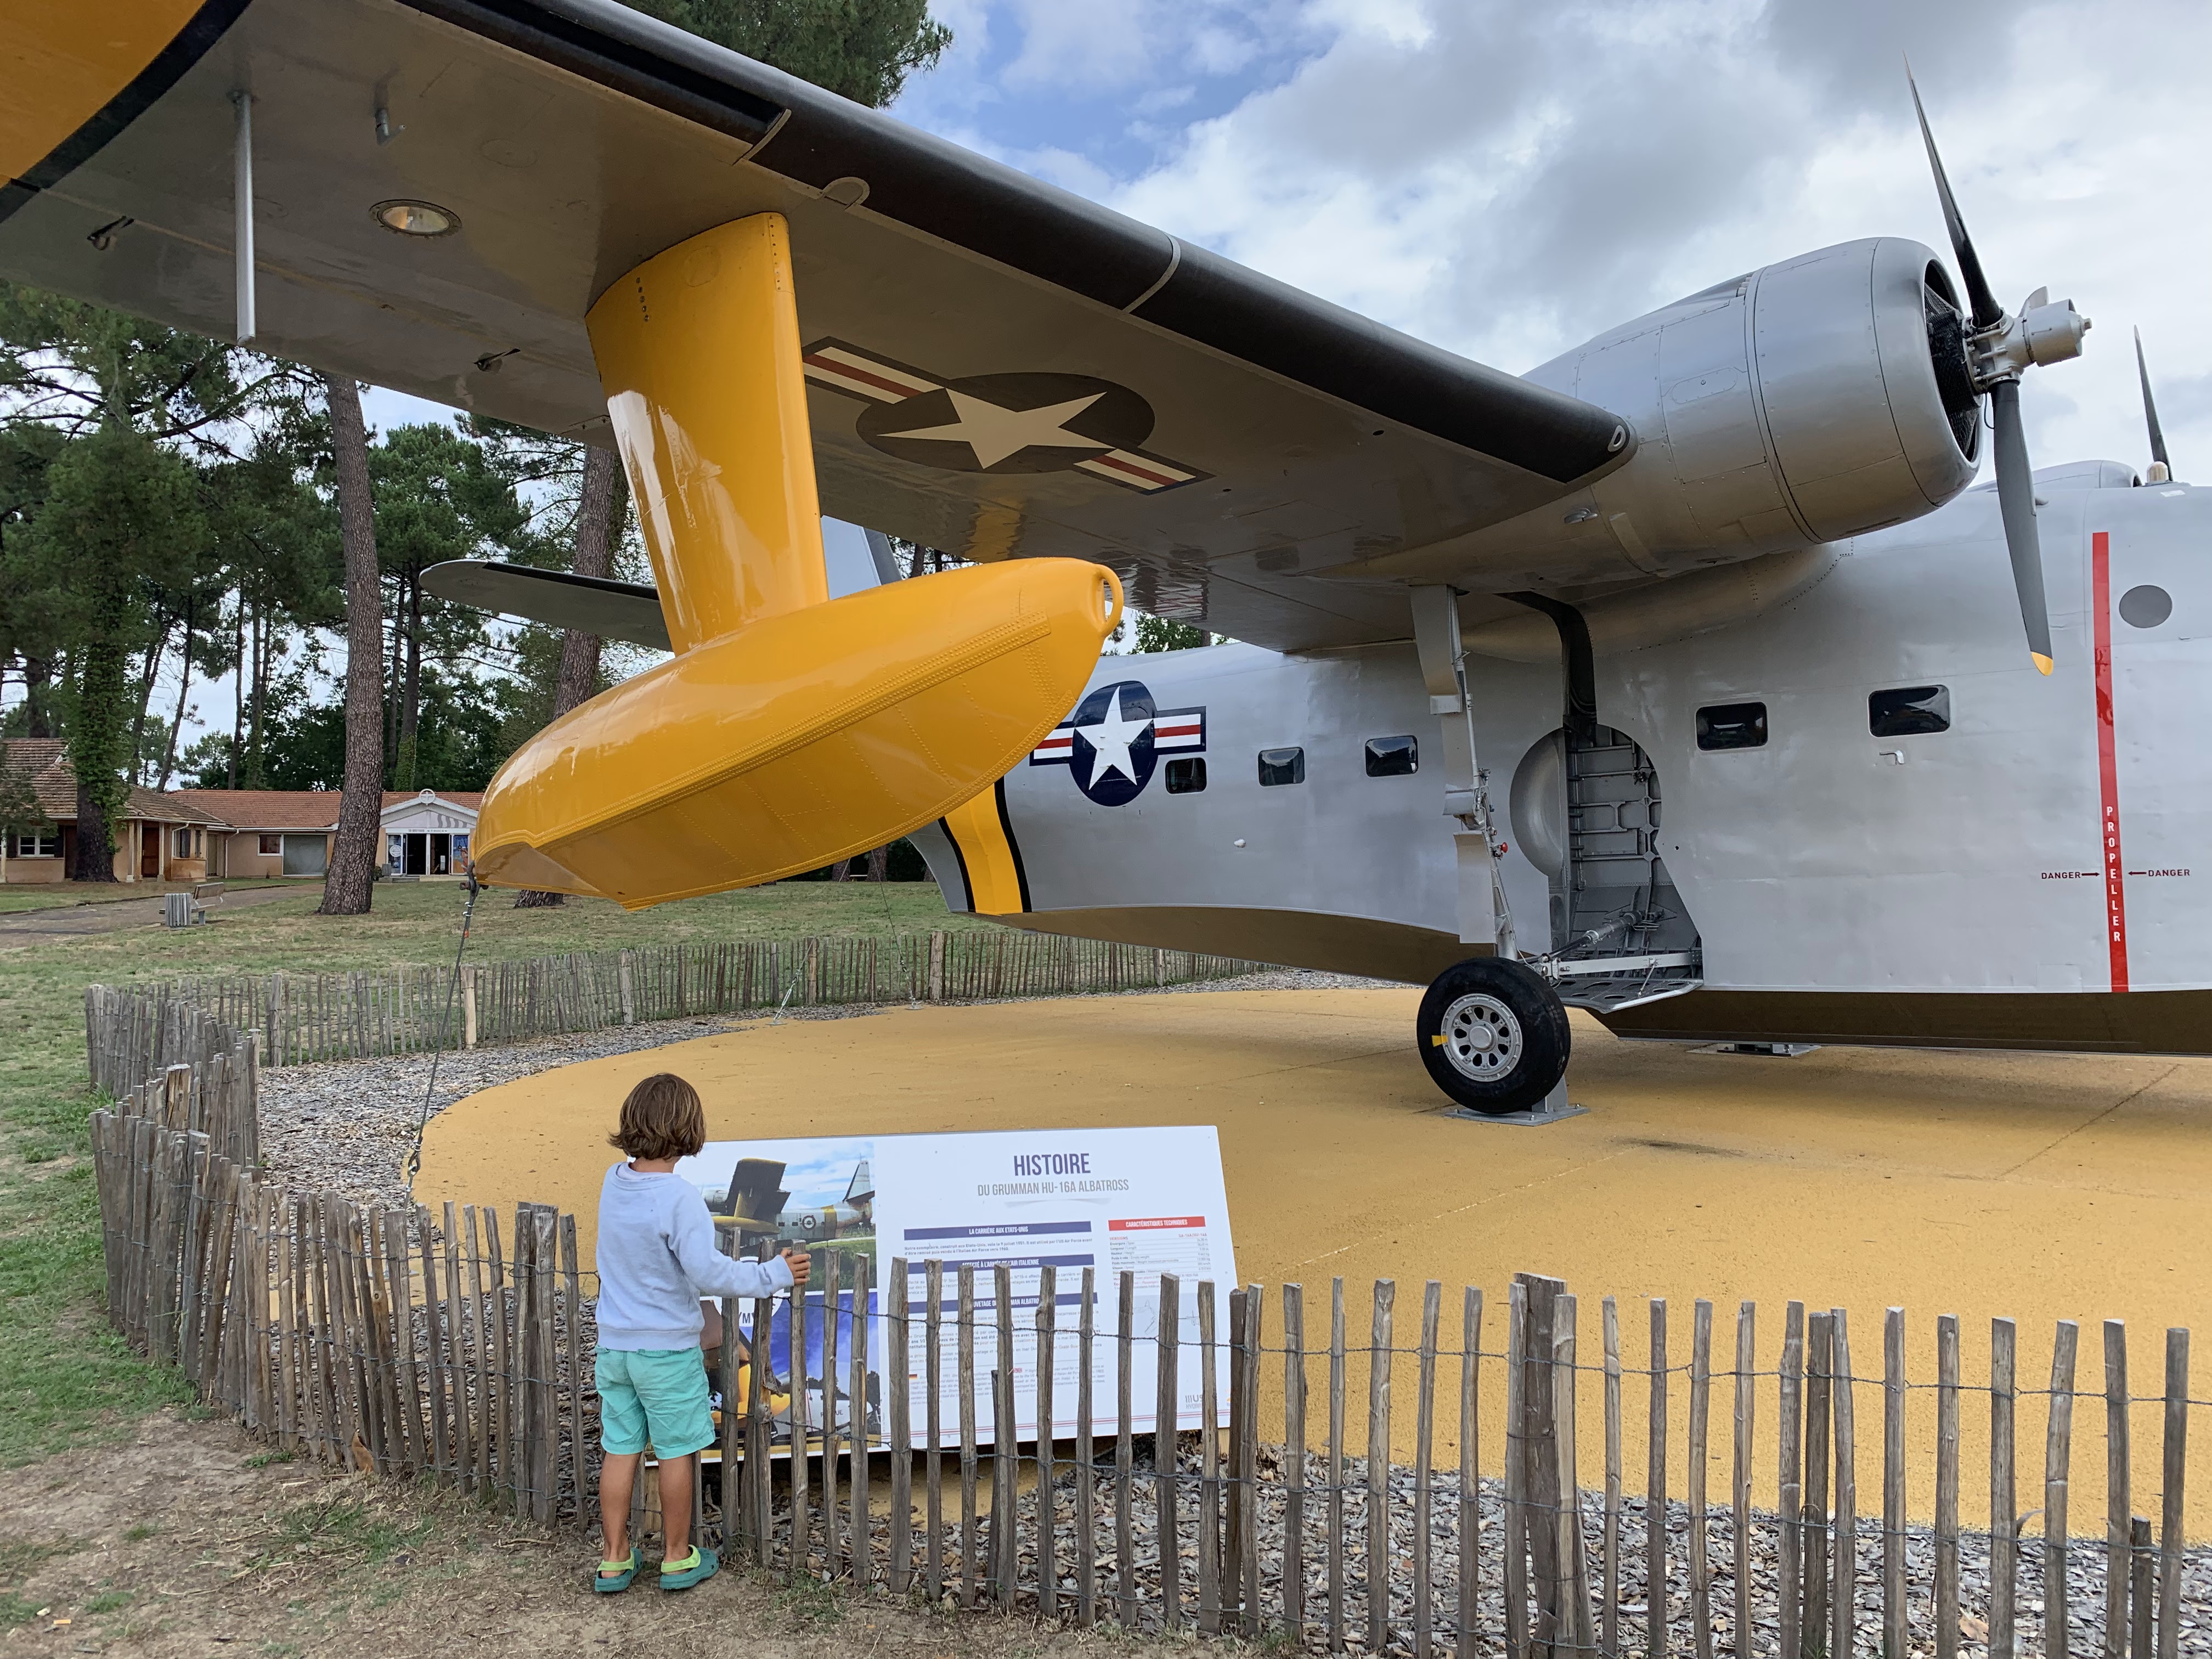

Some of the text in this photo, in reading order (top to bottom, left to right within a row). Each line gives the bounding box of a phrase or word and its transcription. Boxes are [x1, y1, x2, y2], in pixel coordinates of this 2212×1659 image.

[2041, 871, 2081, 879] DANGER
[2107, 806, 2121, 942] PROPELLER
[1013, 1152, 1091, 1176] HISTOIRE
[977, 1178, 1128, 1196] DU GRUMMAN HU-16A ALBATROSS
[975, 1226, 995, 1234] CARRIÈRE
[1125, 1218, 1163, 1228] CARACTÉRISTIQUES
